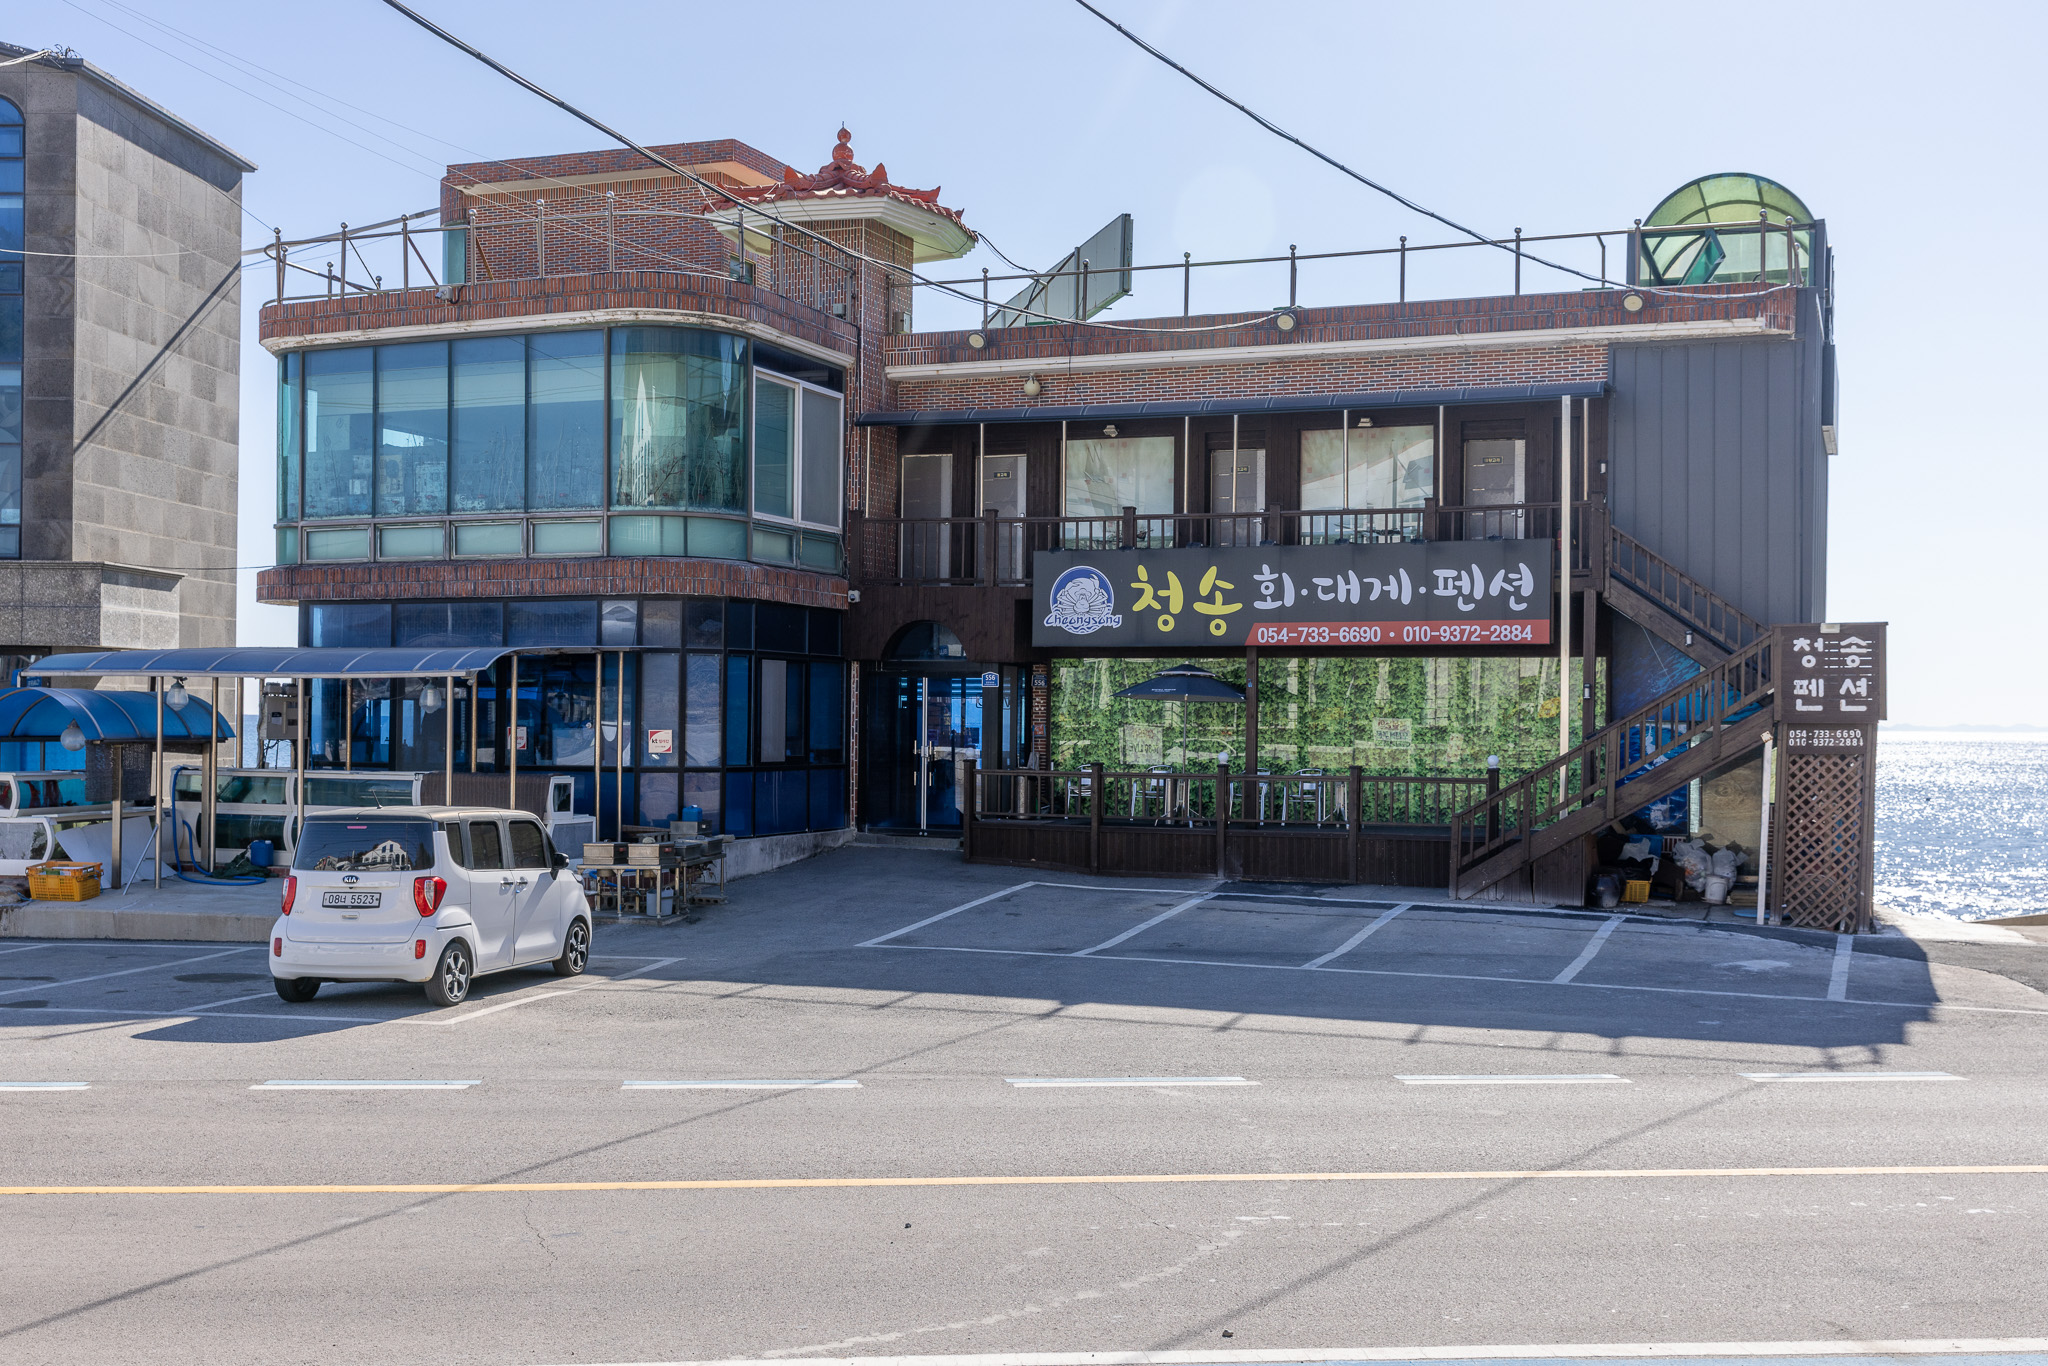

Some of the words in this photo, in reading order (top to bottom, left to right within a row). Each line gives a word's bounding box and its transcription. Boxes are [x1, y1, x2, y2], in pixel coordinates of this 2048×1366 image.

[1131, 564, 1243, 637] 청송
[1045, 614, 1122, 628] Cheongsong
[1257, 627, 1381, 644] 054-733-6690
[1403, 624, 1533, 643] 010-9372-2884
[1792, 636, 1868, 668] 청송
[1793, 677, 1868, 712] 펜션
[328, 894, 347, 904] 08너
[350, 894, 375, 904] 5523
